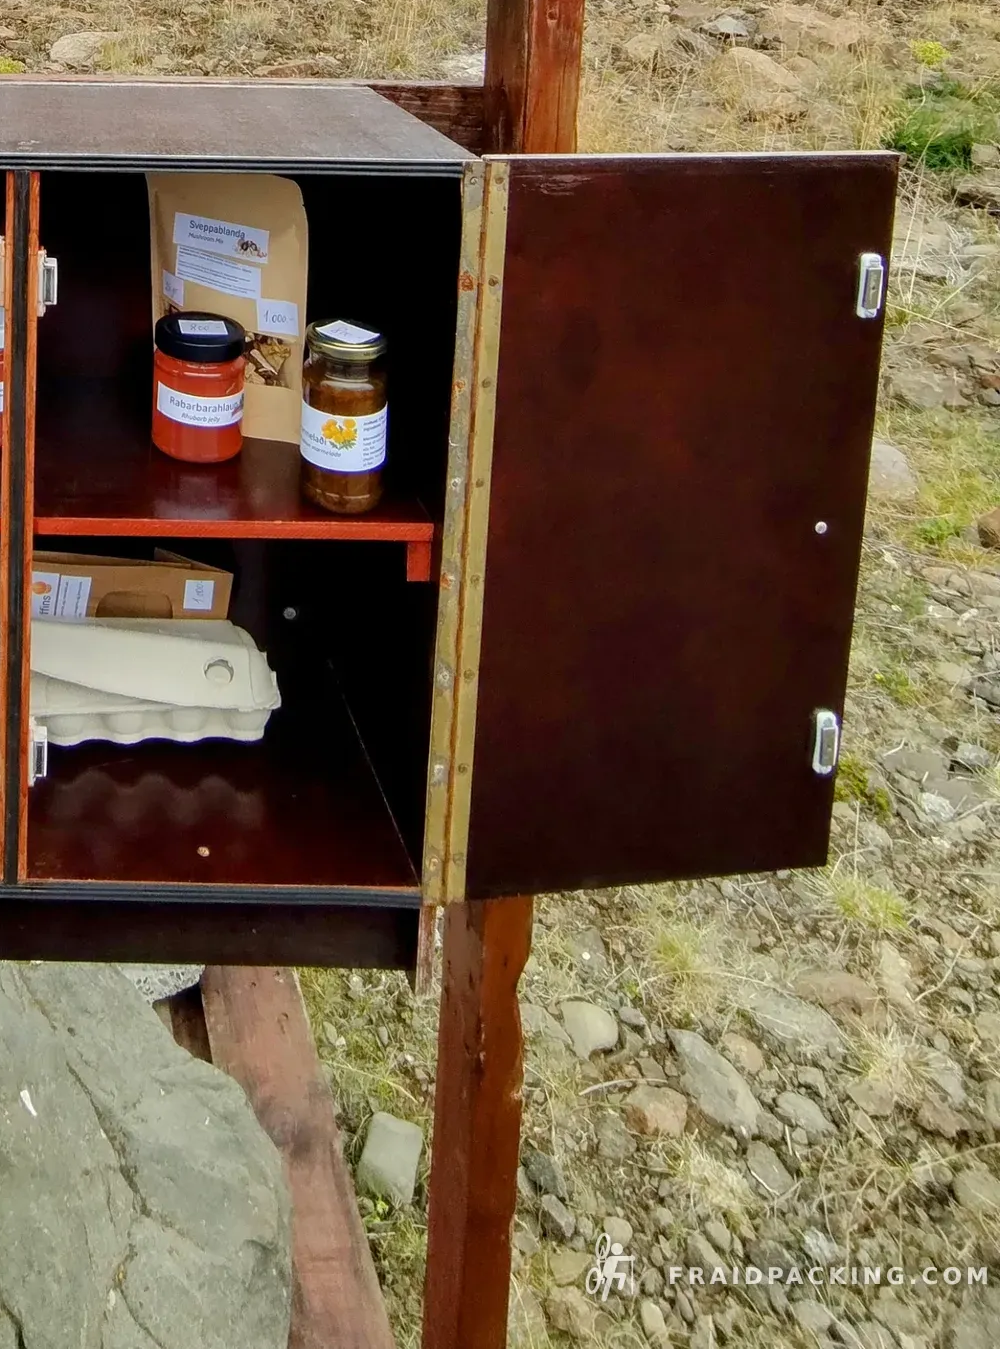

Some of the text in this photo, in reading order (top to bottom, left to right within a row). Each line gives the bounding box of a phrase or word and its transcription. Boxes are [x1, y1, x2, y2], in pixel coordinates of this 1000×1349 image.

[189, 220, 246, 240] Sveppablanda
[188, 232, 215, 243] Mushroom
[181, 412, 207, 422] Rhubarb
